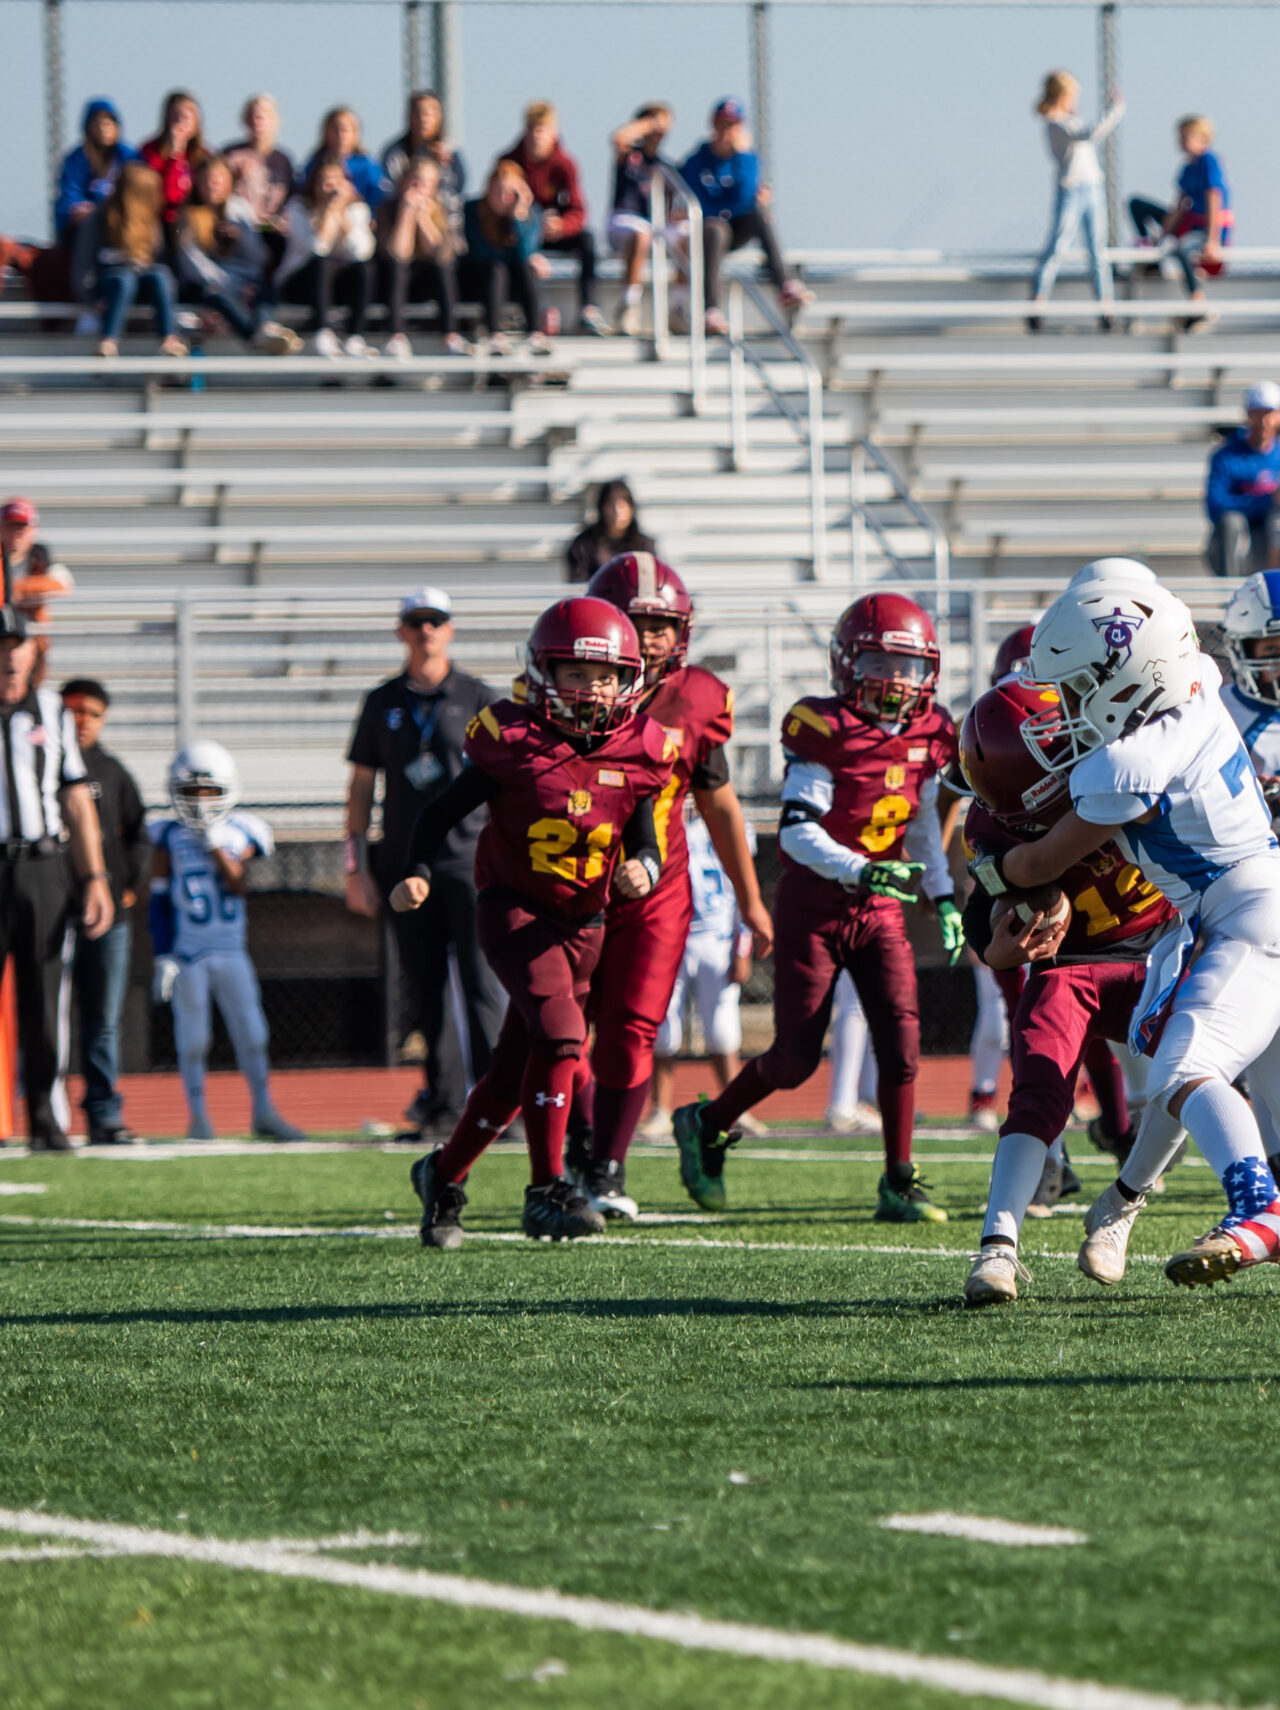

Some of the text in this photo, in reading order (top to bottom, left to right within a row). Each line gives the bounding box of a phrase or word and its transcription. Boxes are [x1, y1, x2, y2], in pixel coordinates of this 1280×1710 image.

[787, 717, 801, 737] 8
[1031, 776, 1058, 798] Riddell
[861, 795, 910, 852] 8
[527, 817, 613, 880] 21
